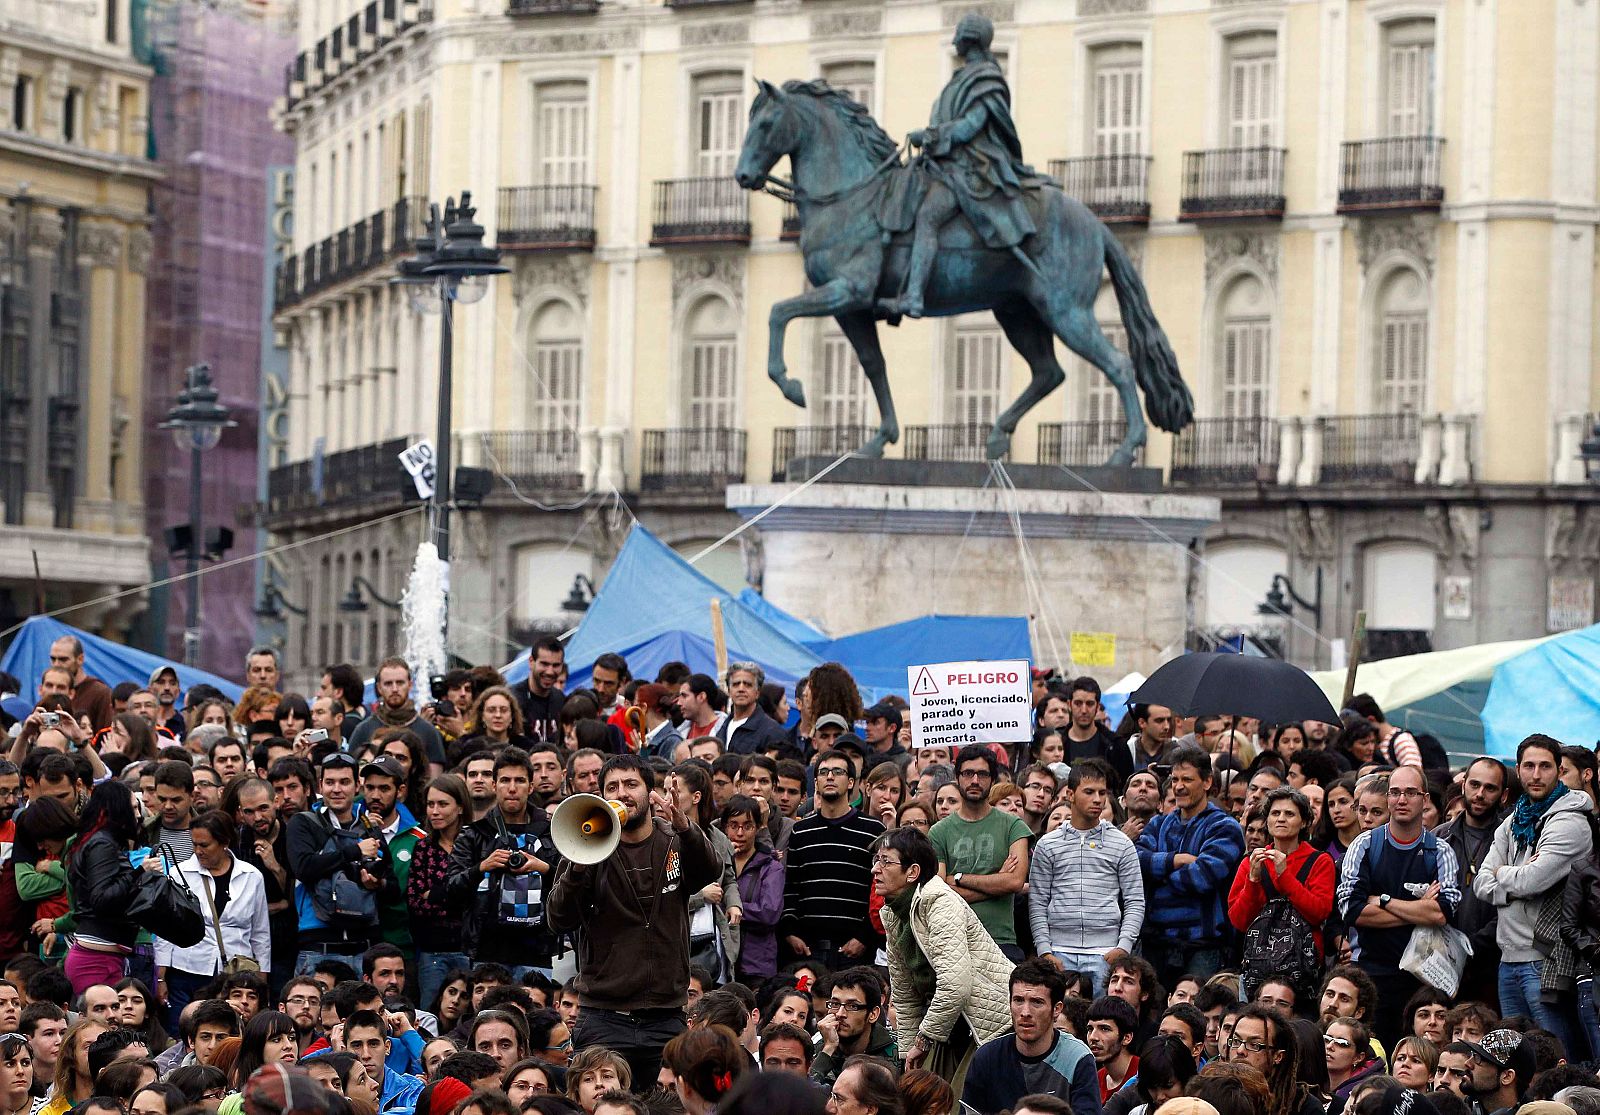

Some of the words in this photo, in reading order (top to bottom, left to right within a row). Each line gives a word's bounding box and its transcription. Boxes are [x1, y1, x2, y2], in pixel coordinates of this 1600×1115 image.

[947, 672, 1019, 686] PELIGRO
[920, 697, 958, 707] Joven,
[961, 694, 1027, 704] licenciado,
[921, 708, 964, 721] parado
[968, 709, 976, 719] y
[922, 721, 966, 733] armado
[970, 721, 993, 730] con
[996, 720, 1019, 729] una
[923, 733, 977, 747] pancarta
